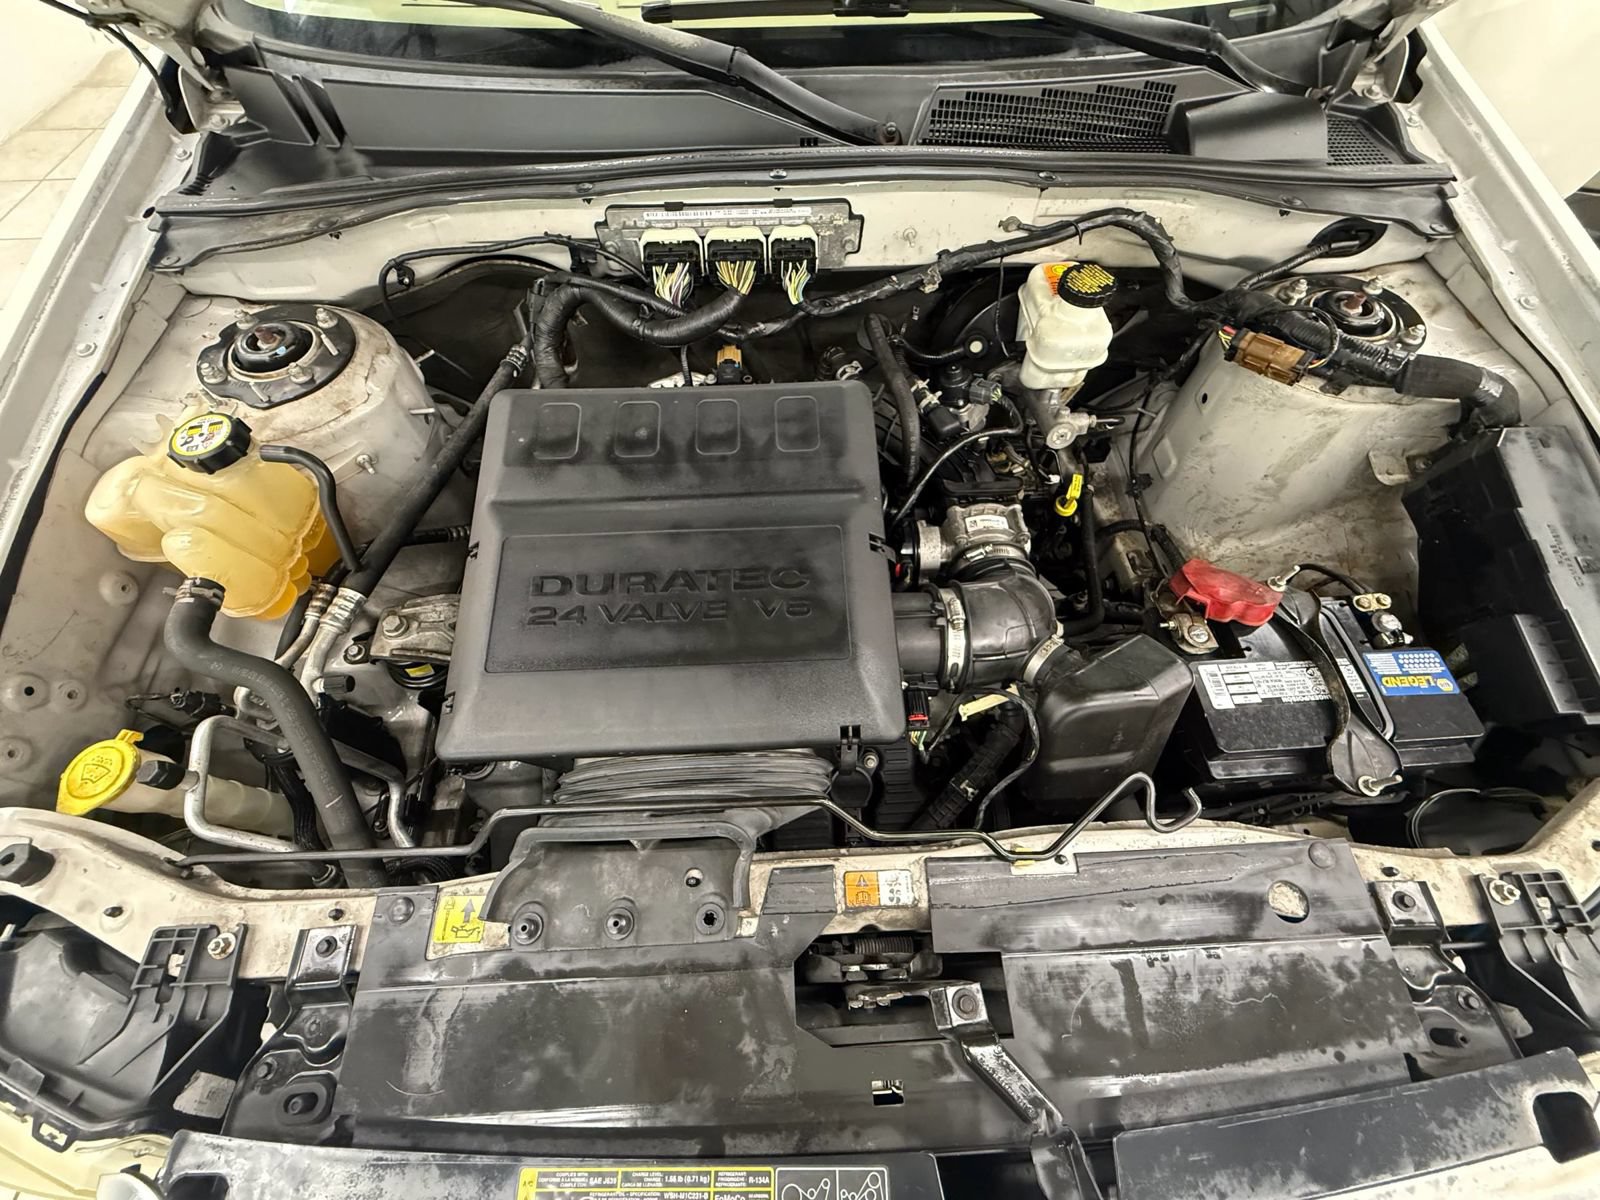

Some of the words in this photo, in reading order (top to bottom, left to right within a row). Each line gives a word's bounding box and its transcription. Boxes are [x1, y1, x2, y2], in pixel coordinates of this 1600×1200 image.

[529, 566, 811, 597] DURATEC
[525, 605, 587, 626] 24
[598, 601, 728, 624] VALVE
[754, 597, 813, 619] V6
[1381, 675, 1435, 687] LEGEND
[700, 1175, 710, 1185] kg)
